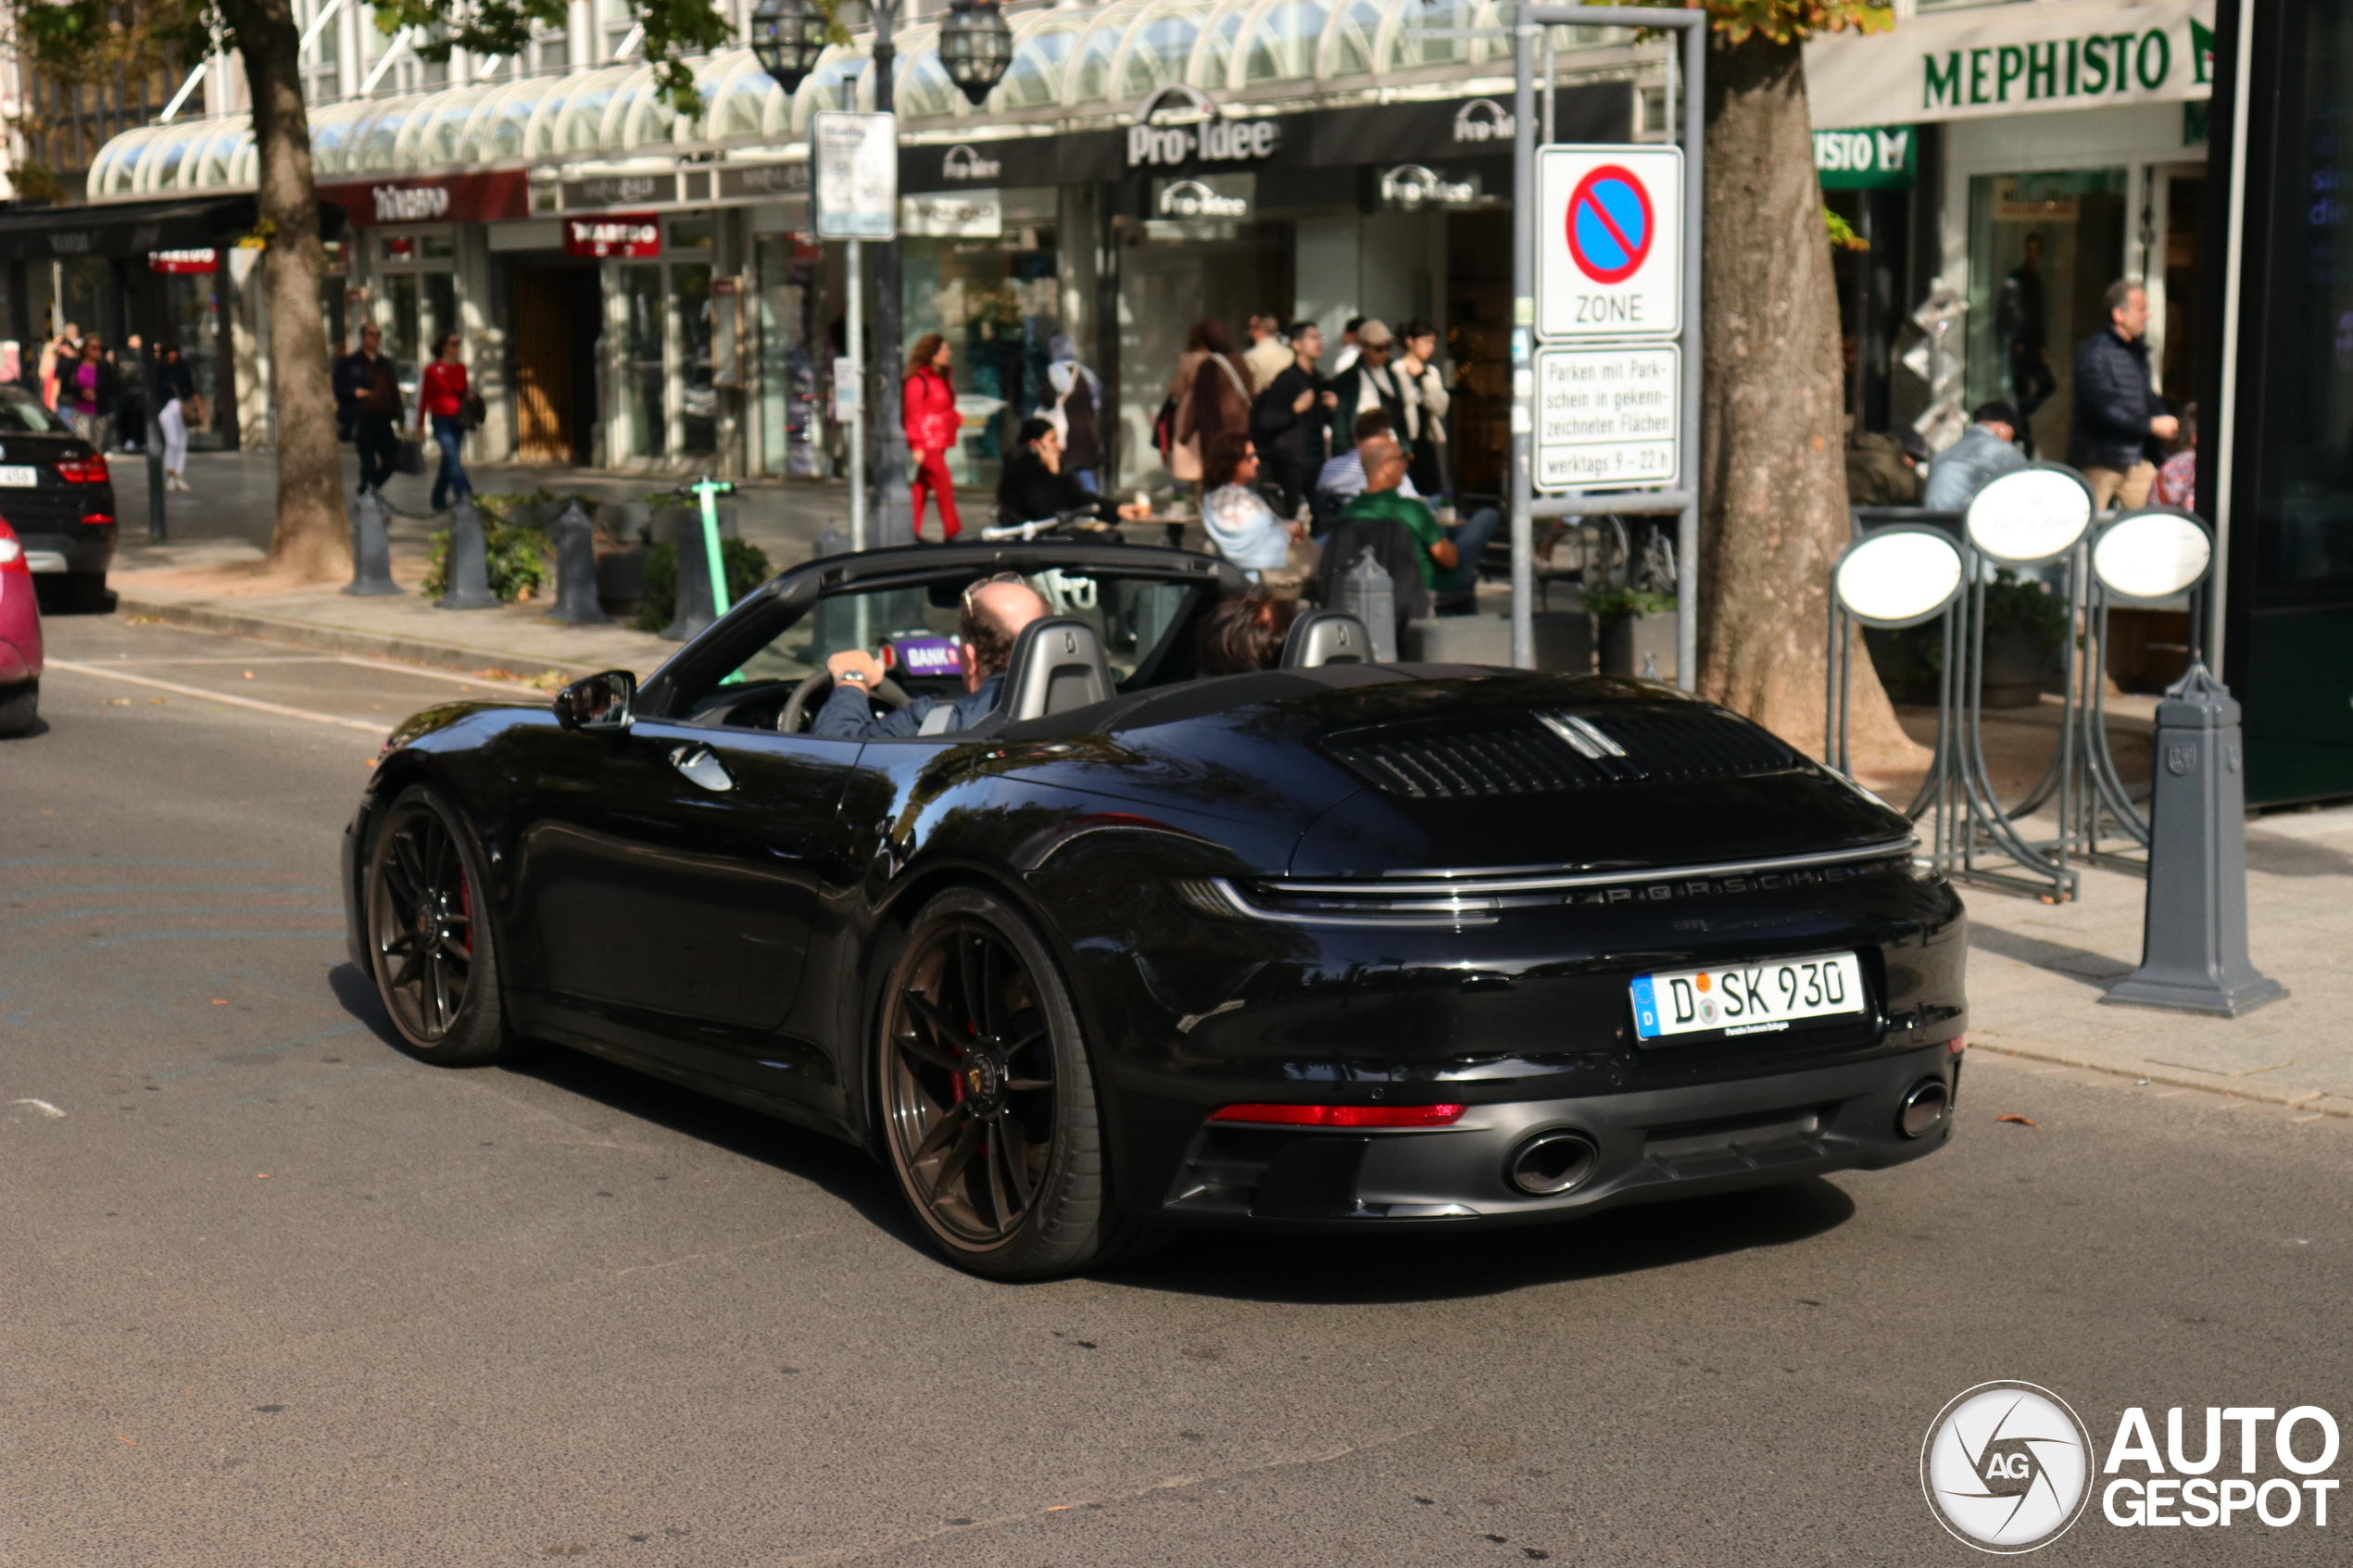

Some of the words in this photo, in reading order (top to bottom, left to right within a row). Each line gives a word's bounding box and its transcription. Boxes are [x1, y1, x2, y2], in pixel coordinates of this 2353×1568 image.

[1923, 28, 2170, 109] MEPHISTO
[1812, 132, 1873, 172] ISTO
[1576, 295, 1643, 322] ZONE
[1549, 361, 1595, 382] Parken
[1603, 359, 1624, 380] mit
[1630, 358, 1667, 379] Park-
[1546, 389, 1590, 409] schein
[1596, 388, 1608, 408] in
[1615, 386, 1669, 411] gekenn-
[1546, 416, 1615, 436] zeichneten
[1621, 413, 1669, 433] Flächen
[1548, 455, 1609, 477] werktags
[1616, 451, 1623, 470] 9
[1640, 450, 1655, 470] 22
[1661, 449, 1668, 468] h
[1607, 869, 1845, 904] PORSCHE
[1669, 978, 1695, 1024] D
[1721, 969, 1770, 1017] SK
[1779, 960, 1844, 1011] 930
[1642, 1011, 1654, 1026] D
